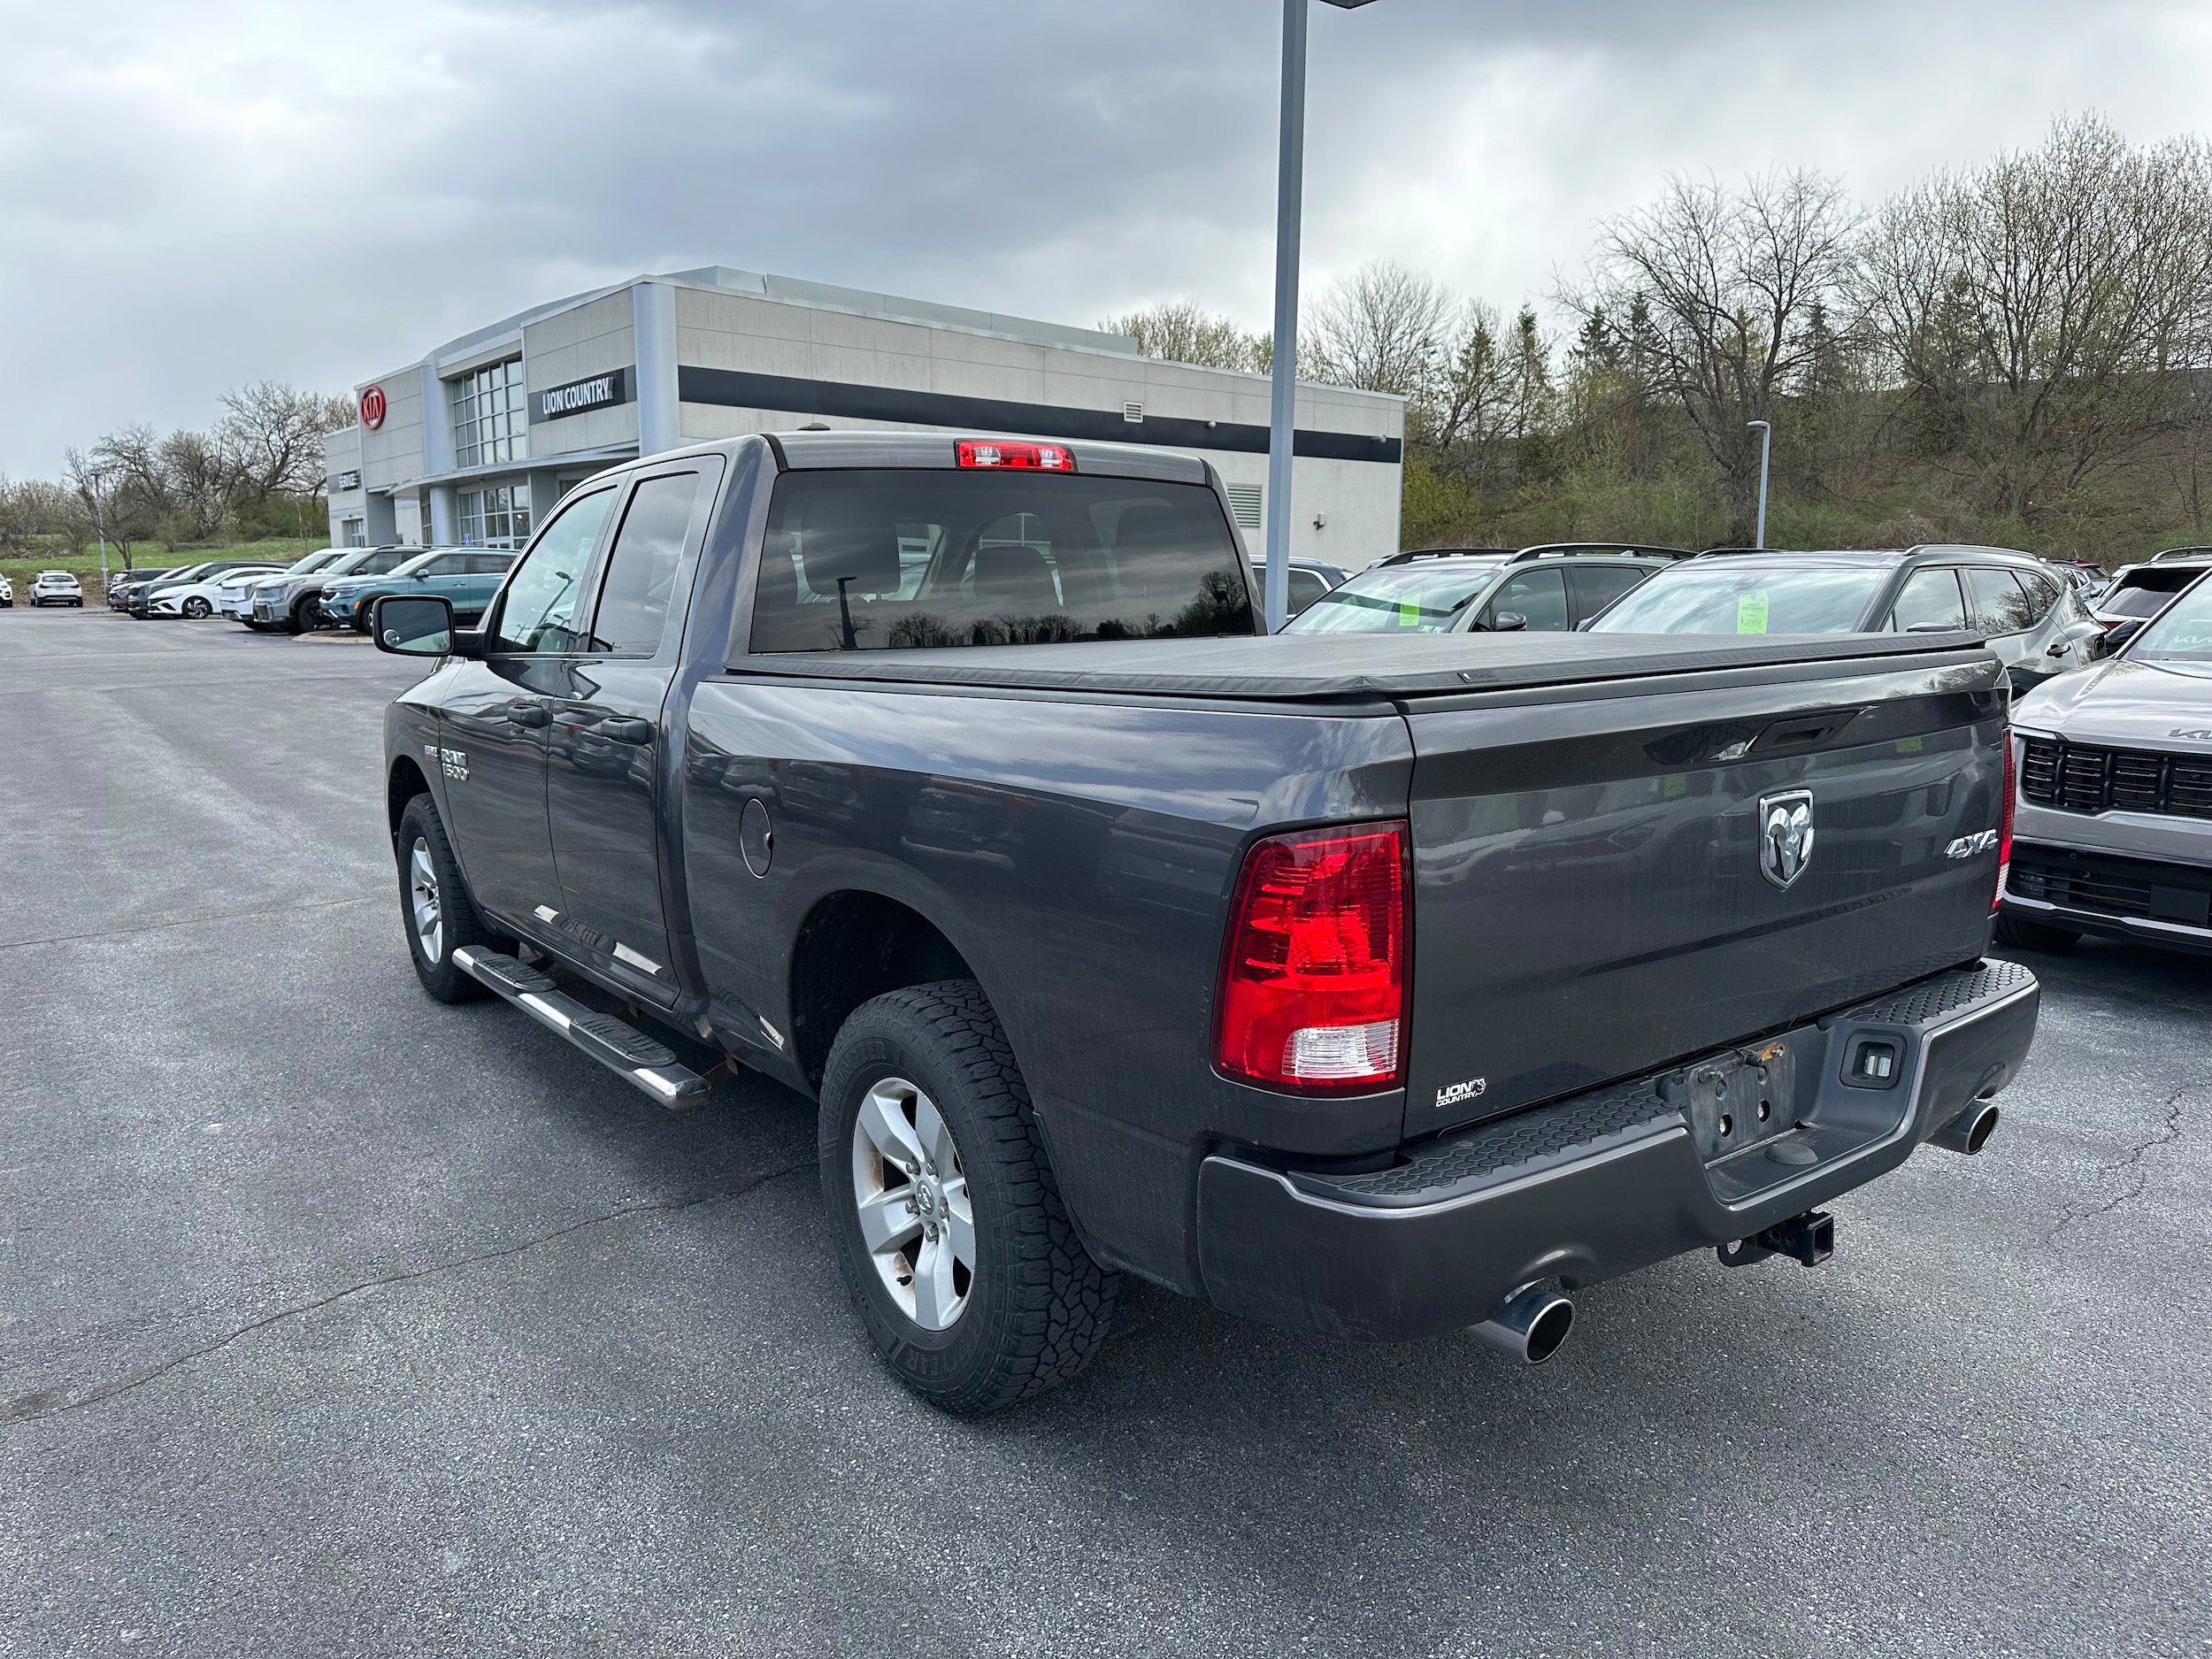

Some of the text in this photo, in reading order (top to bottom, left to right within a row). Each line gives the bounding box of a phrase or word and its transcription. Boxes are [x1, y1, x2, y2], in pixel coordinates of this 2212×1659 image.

[542, 377, 611, 415] LION COUNTRY
[2168, 728, 2212, 740] KI
[1435, 1090, 1477, 1108] COUNTRY
[1436, 1080, 1473, 1101] LION
